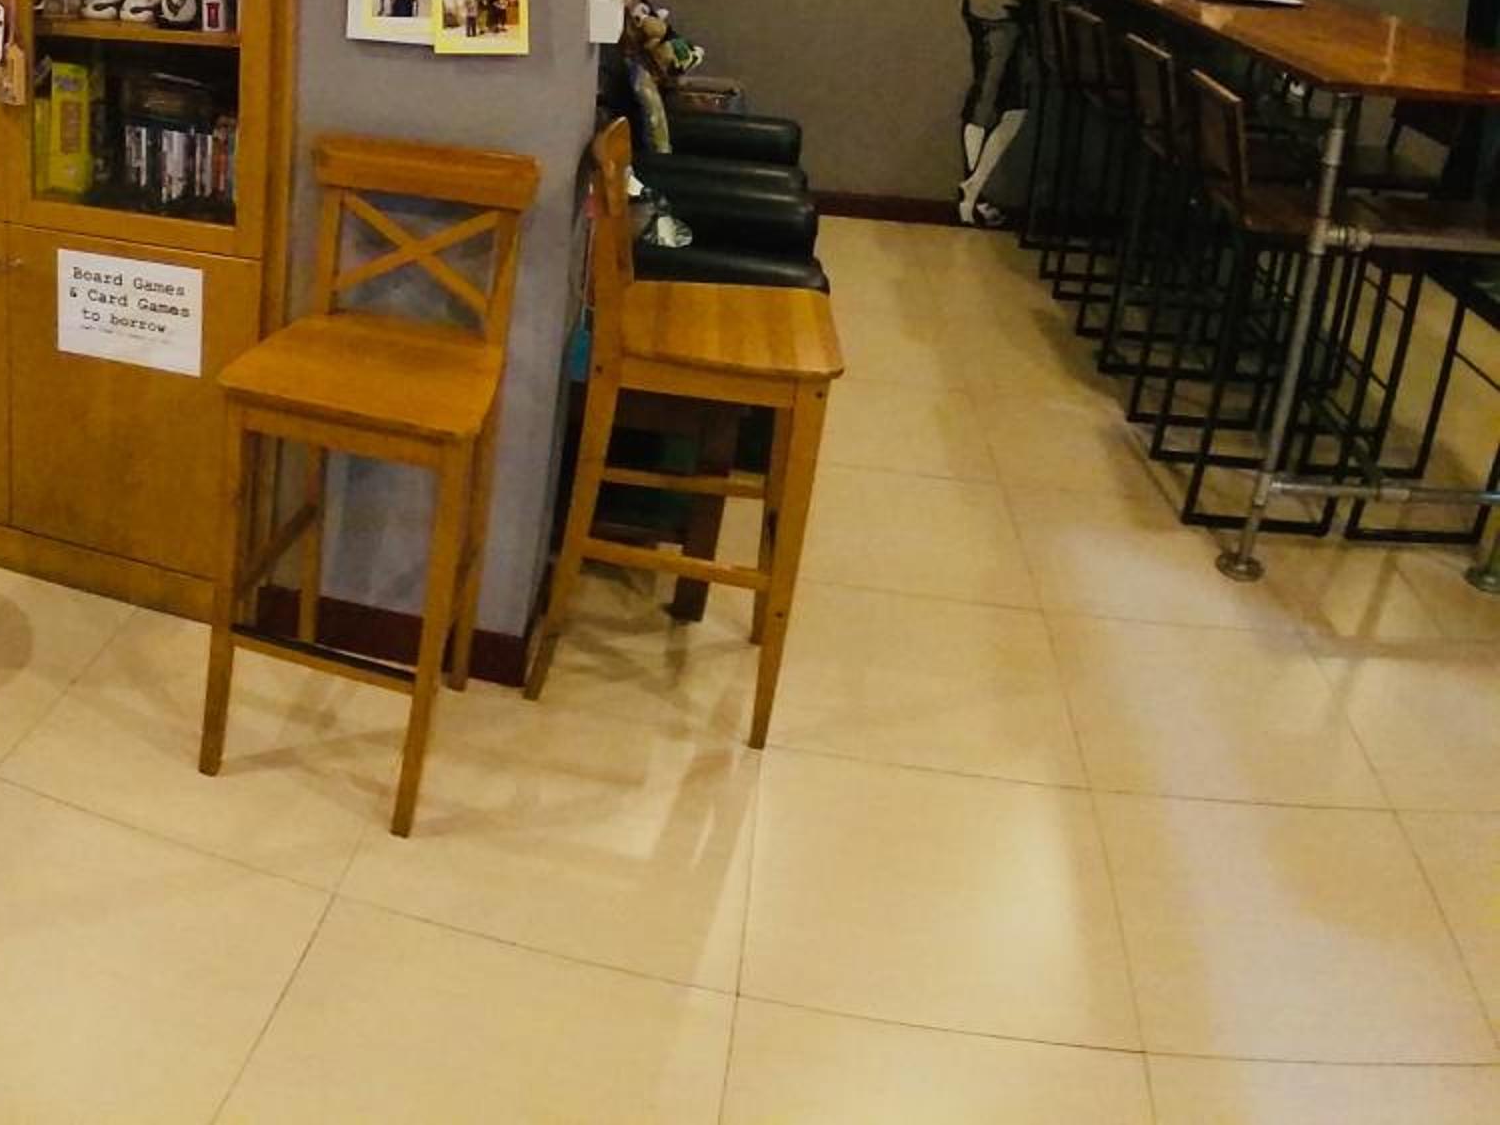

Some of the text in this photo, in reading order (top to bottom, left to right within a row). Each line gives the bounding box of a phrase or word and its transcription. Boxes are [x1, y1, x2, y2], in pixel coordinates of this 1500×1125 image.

[73, 266, 185, 296] Board Games
[69, 287, 190, 318] & Card Games
[82, 309, 167, 333] to borrow
